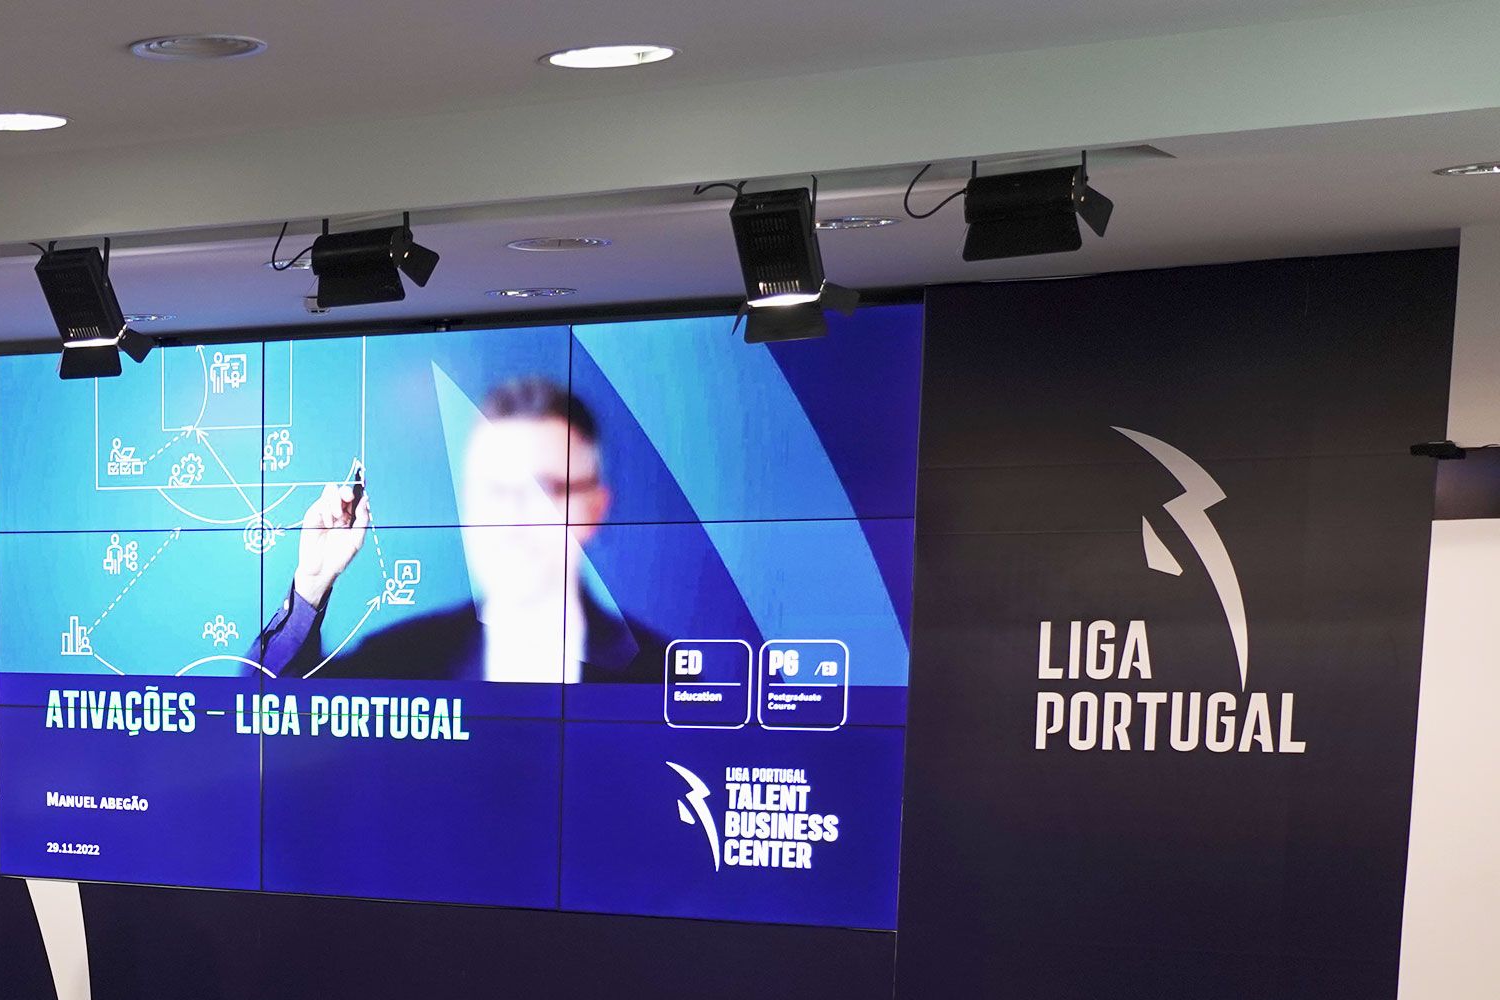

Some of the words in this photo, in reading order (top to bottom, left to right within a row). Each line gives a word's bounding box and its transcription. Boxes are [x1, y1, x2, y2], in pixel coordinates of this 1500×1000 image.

[675, 649, 703, 675] ED
[768, 649, 799, 677] PG
[1038, 620, 1152, 680] LIGA
[674, 691, 722, 702] Education
[767, 702, 796, 711] Course
[768, 692, 822, 703] Postgraduate
[45, 686, 196, 736] ATIVAÇÕES
[235, 694, 301, 735] LIGA
[310, 695, 470, 740] PORTUGAL
[1035, 691, 1306, 753] PORTUGAL
[726, 767, 750, 782] LIGA
[752, 767, 807, 784] PORTUGAL
[725, 783, 811, 812] TALENT
[724, 810, 839, 842] BUSINESS
[46, 842, 100, 856] 29.11.2022
[724, 838, 812, 869] CENTER
